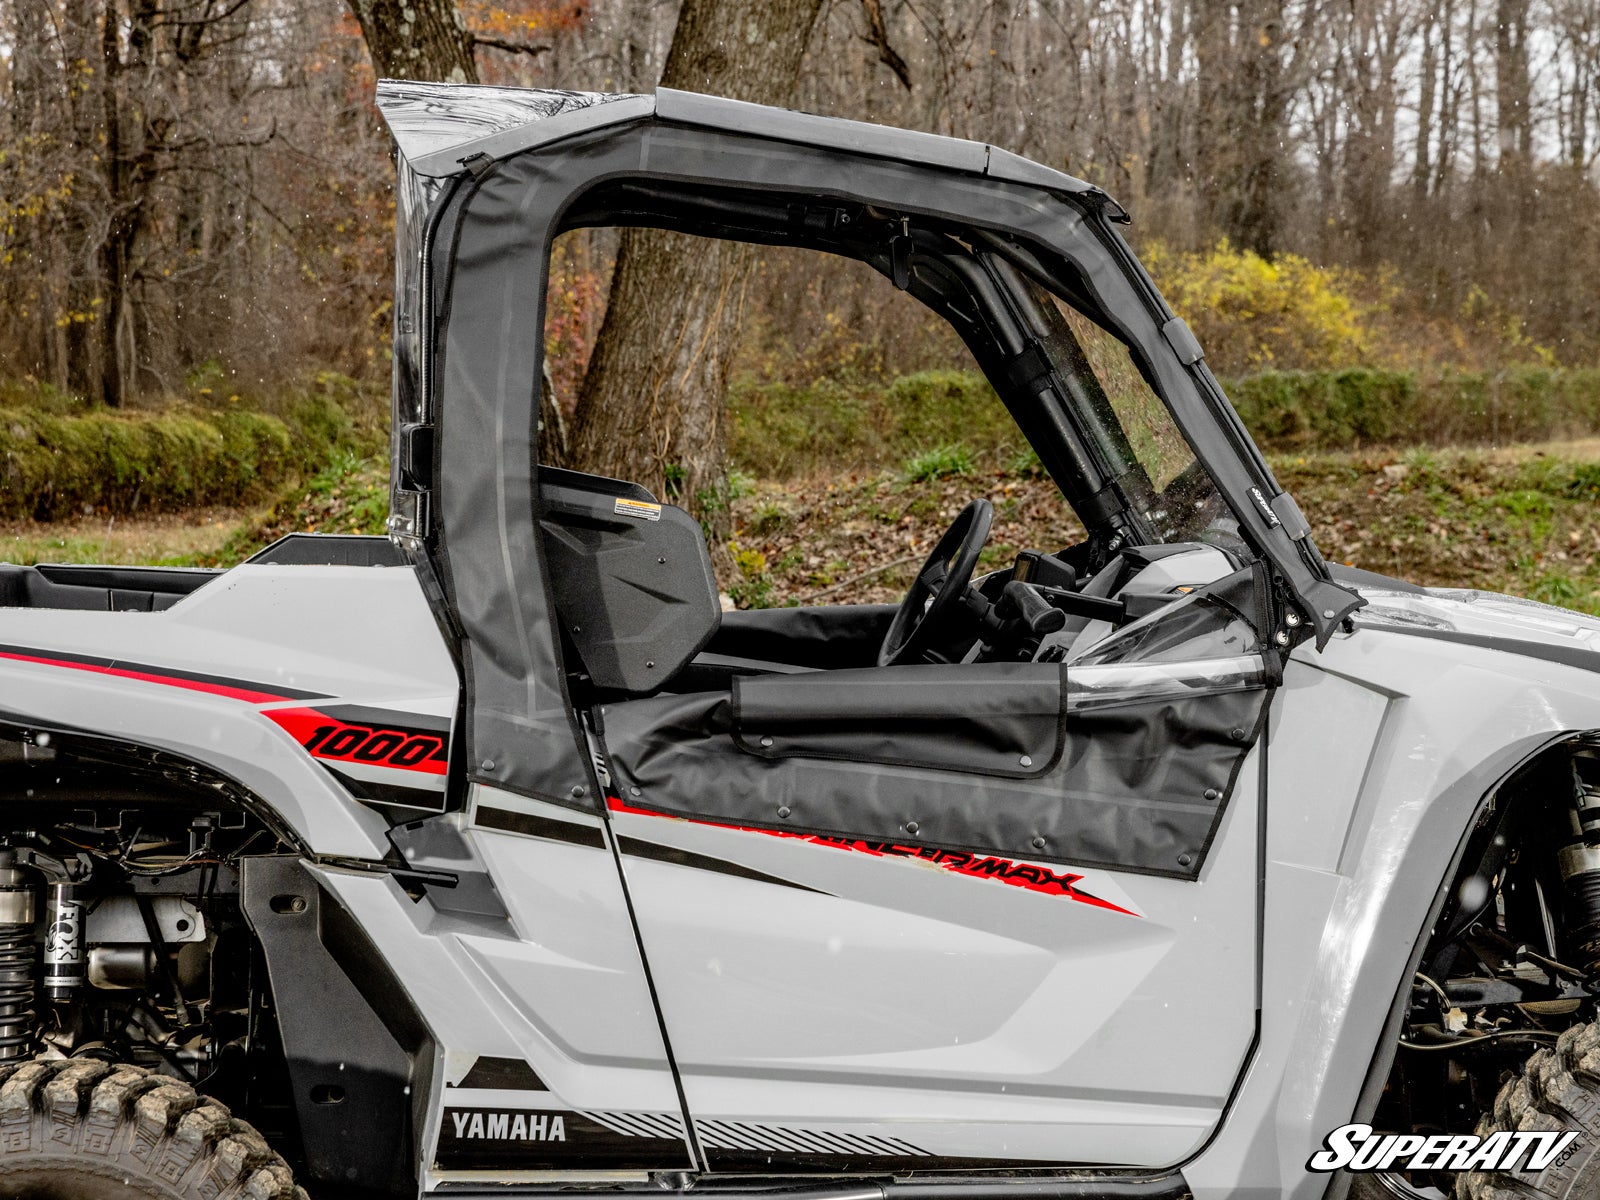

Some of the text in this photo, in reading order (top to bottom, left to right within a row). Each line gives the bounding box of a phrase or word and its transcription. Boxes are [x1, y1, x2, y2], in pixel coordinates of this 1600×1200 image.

[303, 725, 440, 766] 1000
[50, 904, 80, 961] FOX
[451, 1111, 567, 1142] YAMAHA
